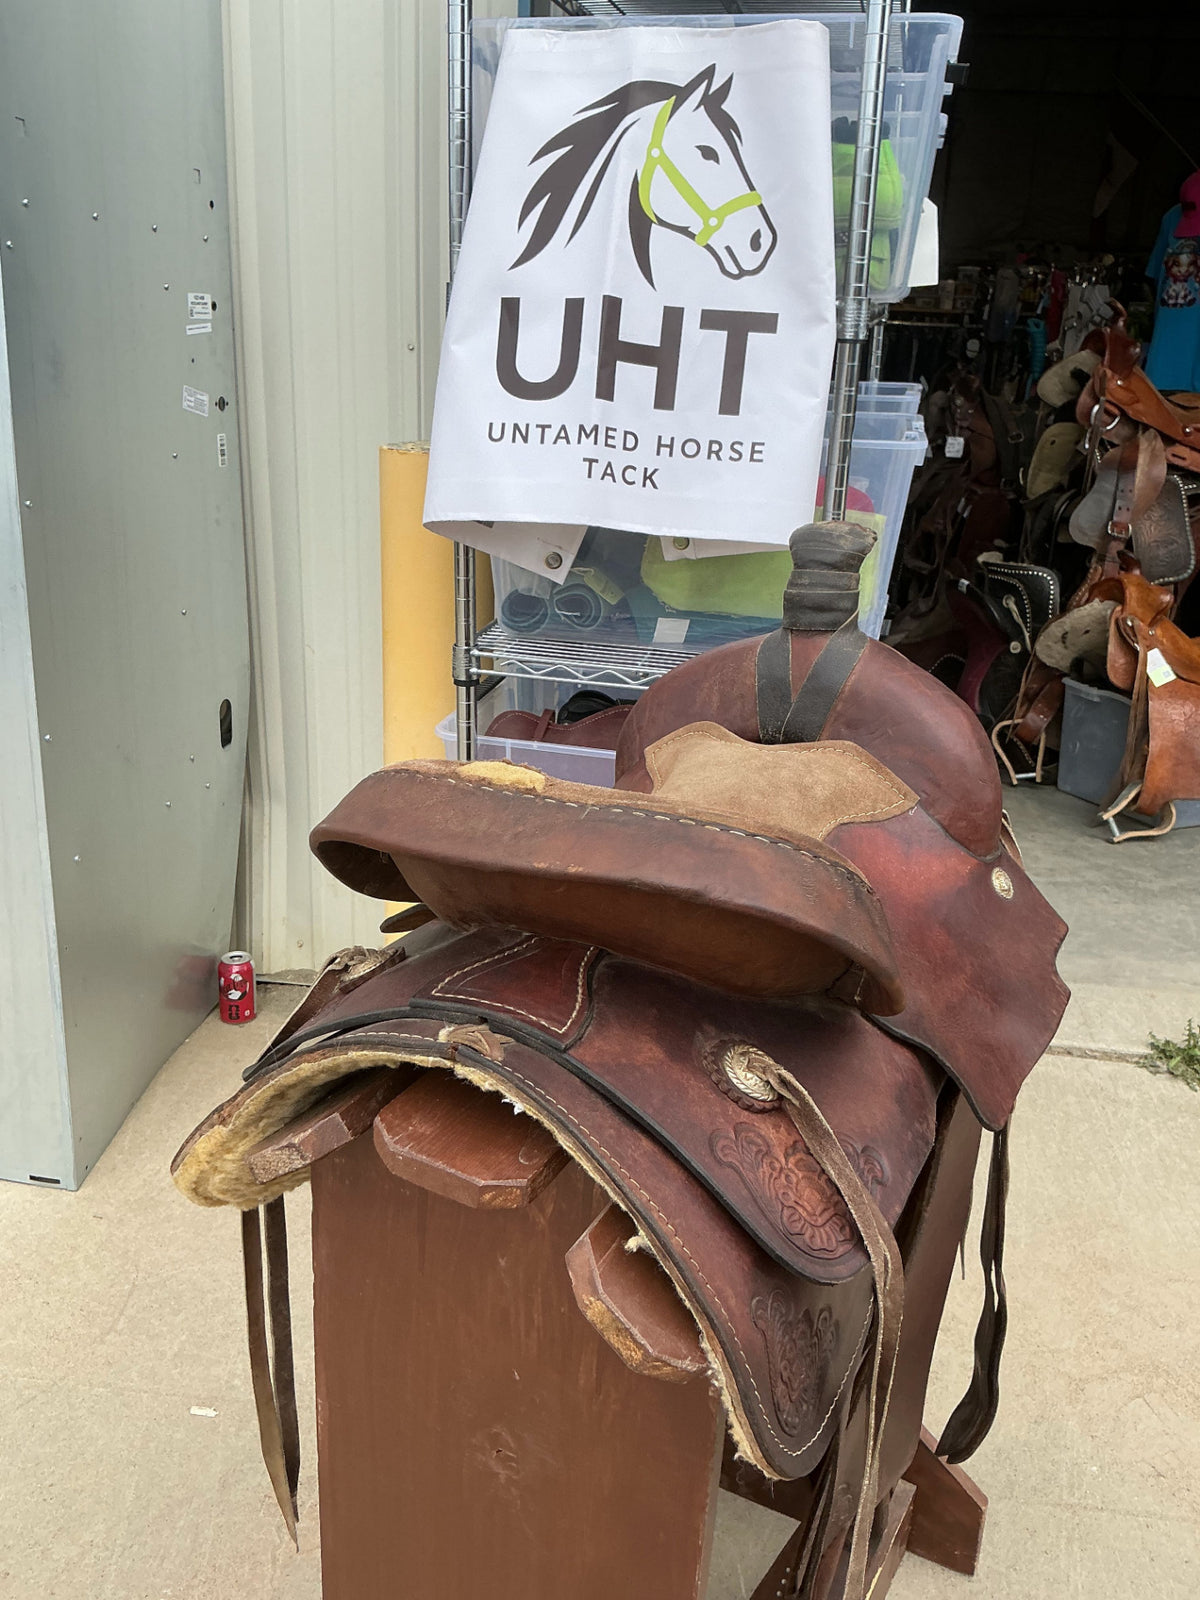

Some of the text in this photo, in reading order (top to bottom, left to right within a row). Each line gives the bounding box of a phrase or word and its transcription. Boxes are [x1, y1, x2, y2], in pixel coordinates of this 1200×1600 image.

[495, 294, 779, 417] UHT
[488, 422, 765, 463] UNTAMED HORSE
[582, 457, 660, 490] TACK
